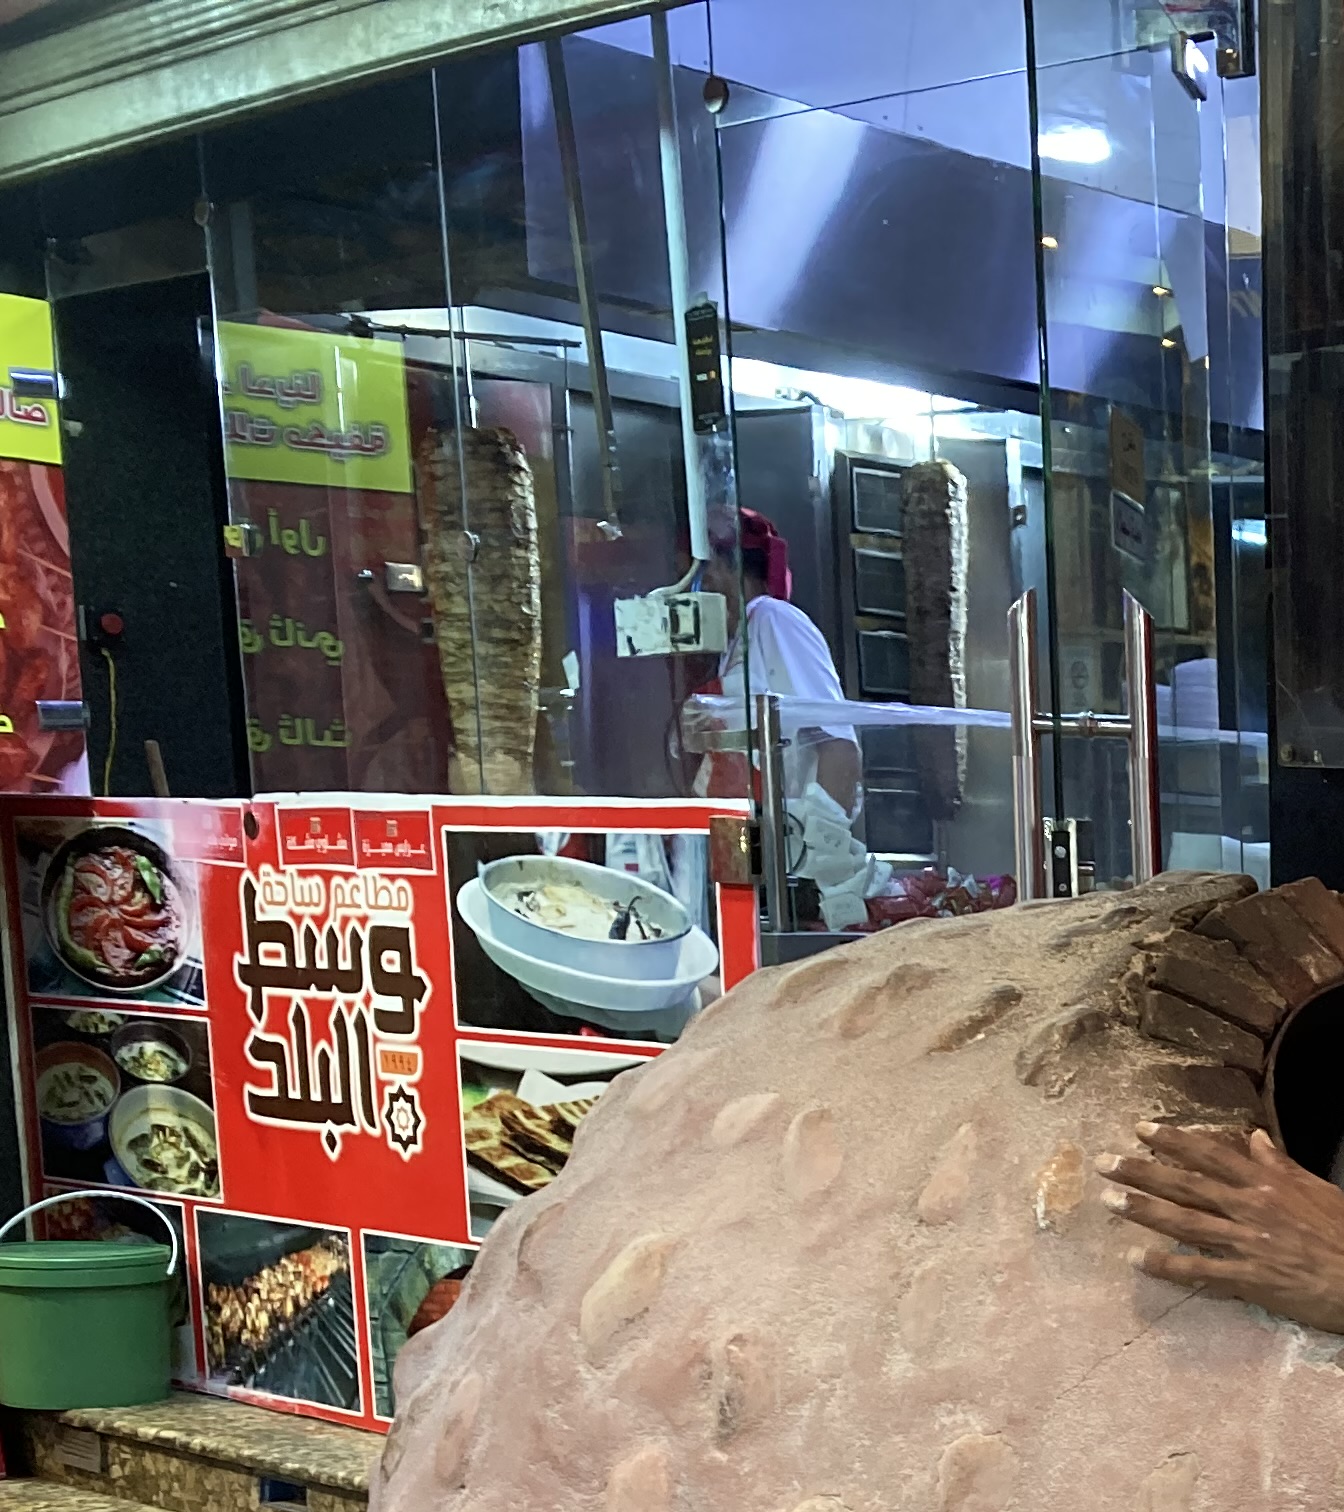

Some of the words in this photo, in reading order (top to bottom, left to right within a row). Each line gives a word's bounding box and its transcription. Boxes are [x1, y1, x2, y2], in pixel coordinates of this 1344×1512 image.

[262, 870, 322, 908] ساحة
[333, 874, 410, 922] مطاعم
[238, 877, 427, 1035] وسط
[247, 1001, 376, 1153] البلد
